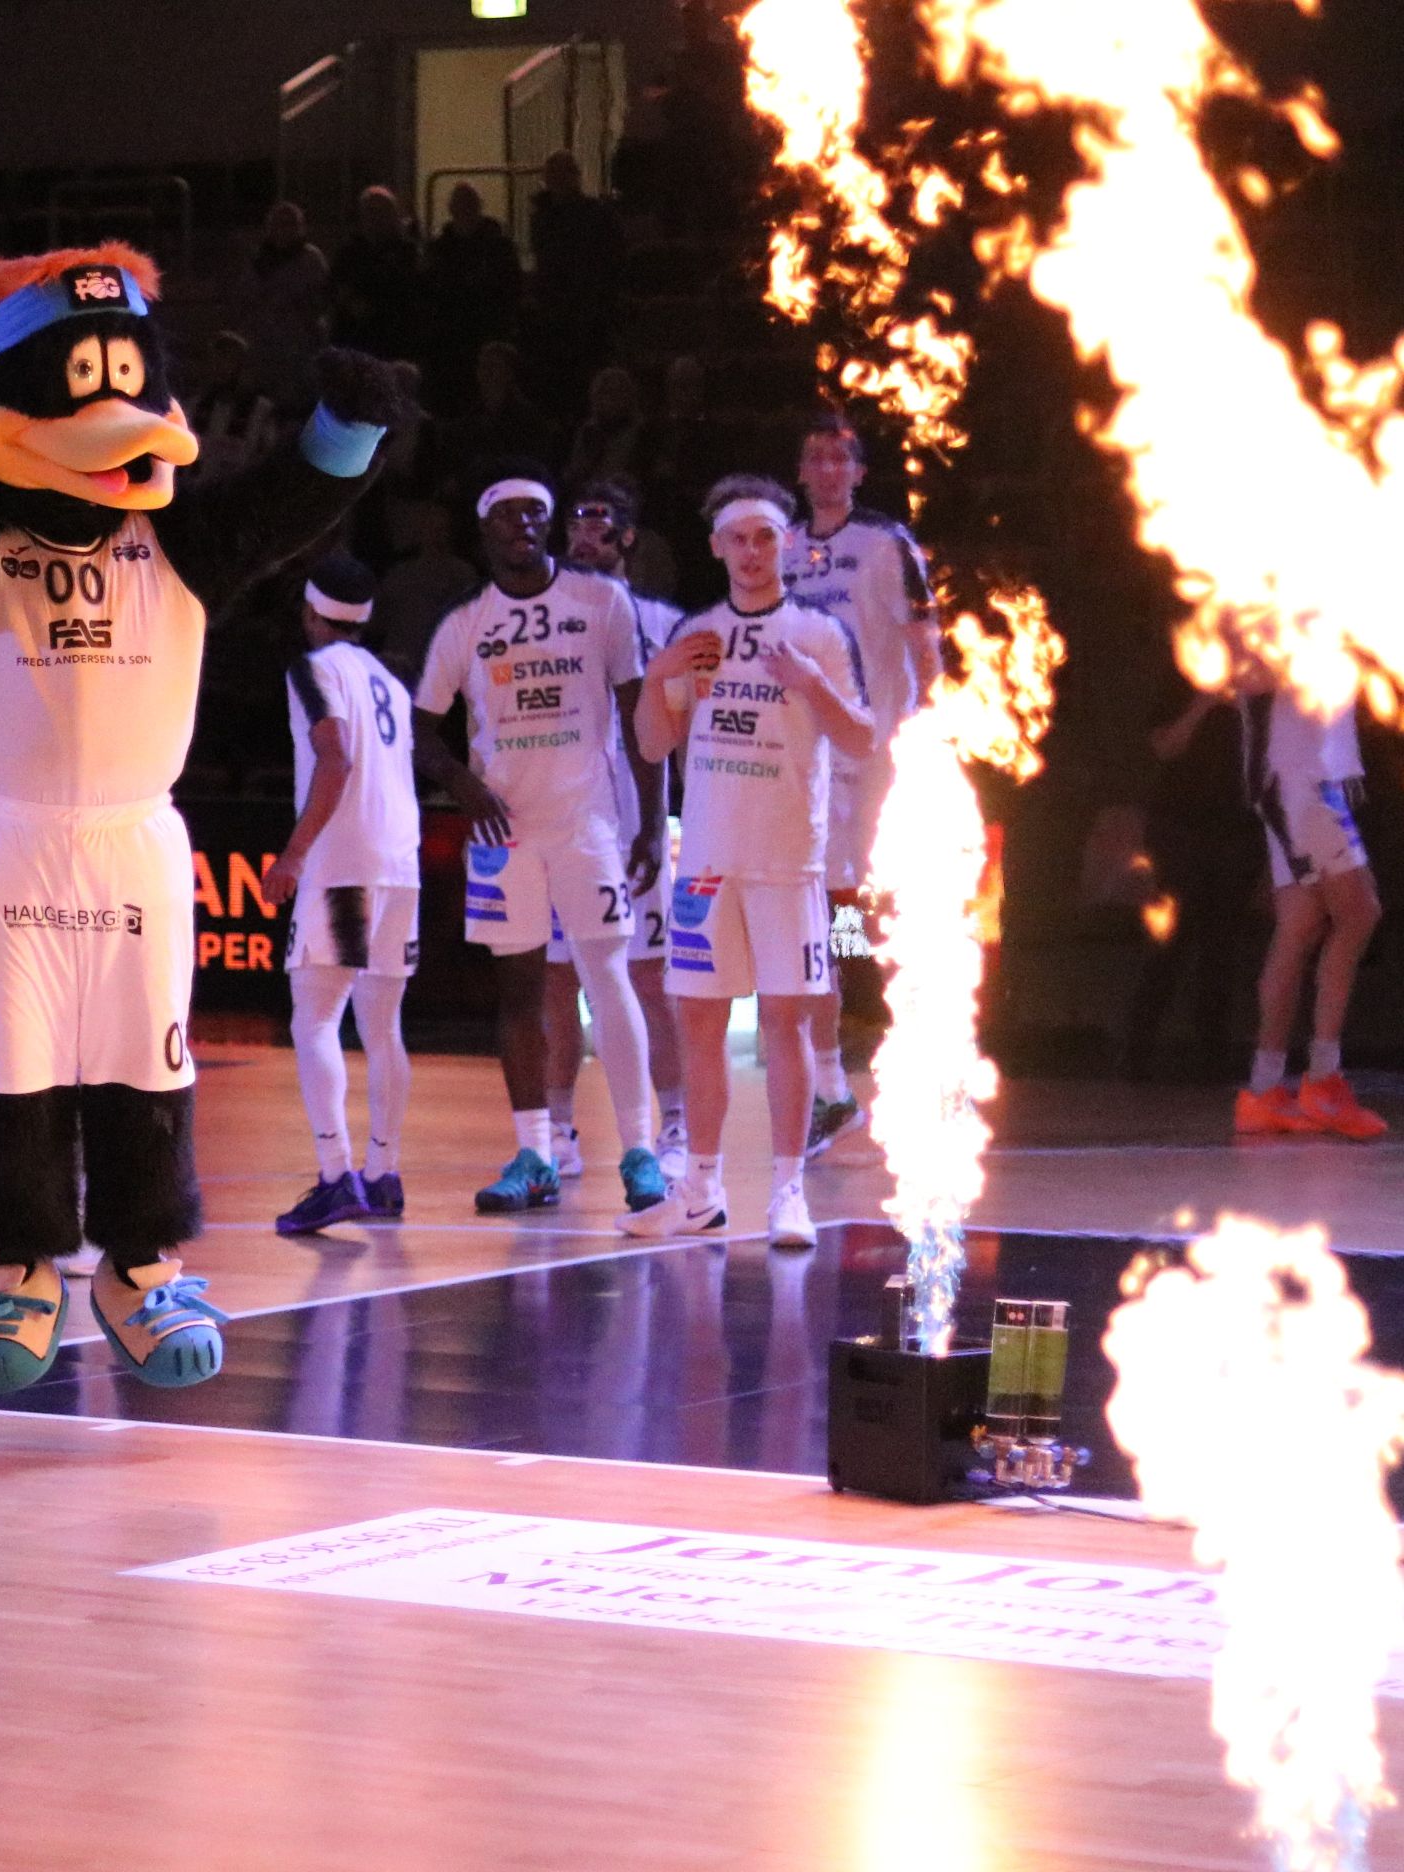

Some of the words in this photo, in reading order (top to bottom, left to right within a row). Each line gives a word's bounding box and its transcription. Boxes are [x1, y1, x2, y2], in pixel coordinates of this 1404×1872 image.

[510, 604, 551, 645] 23
[726, 624, 763, 661] 15
[17, 656, 50, 667] FREDE
[55, 654, 114, 665] ANDERSEN
[118, 656, 125, 664] &
[129, 654, 152, 664] SØN
[514, 656, 583, 680] STARK
[370, 674, 396, 747] 8
[712, 681, 789, 706] STARK
[495, 728, 580, 752] SYNTEGON
[4, 904, 116, 926] HAUGE-BYG
[598, 883, 630, 924] 23
[804, 942, 824, 982] 15
[450, 1571, 741, 1606] Maler
